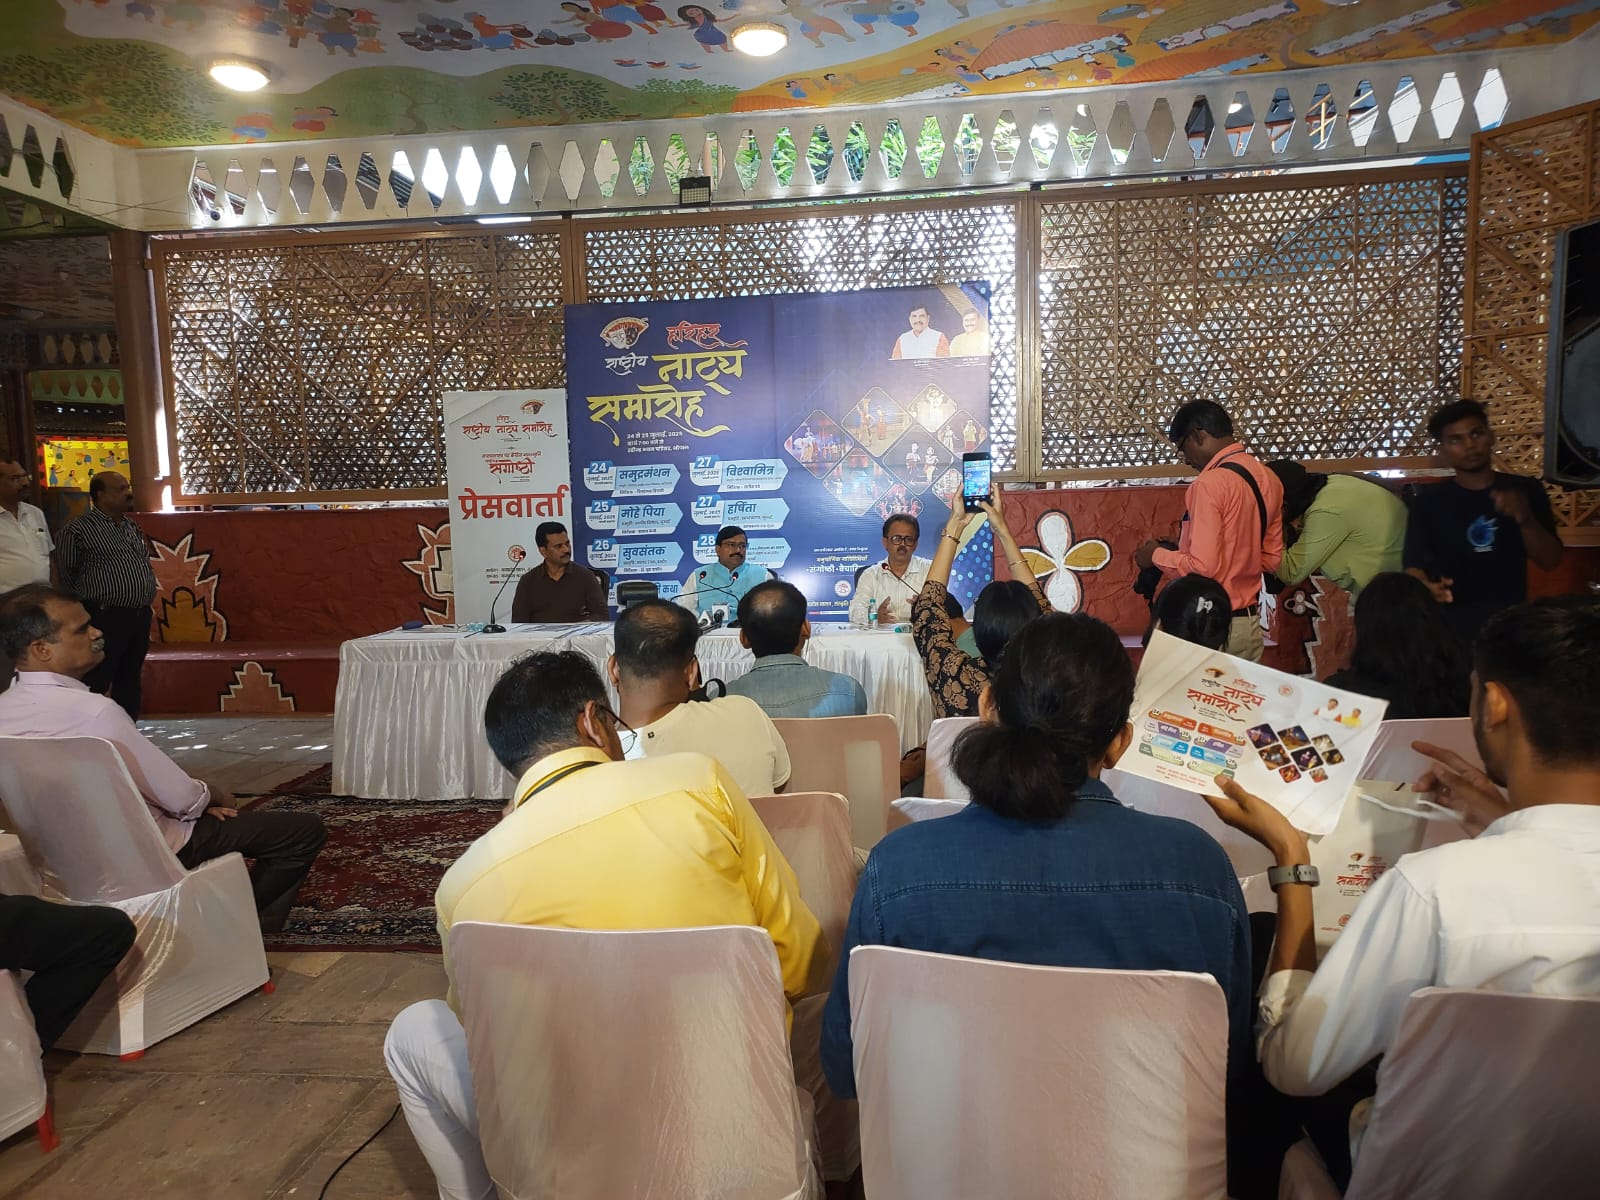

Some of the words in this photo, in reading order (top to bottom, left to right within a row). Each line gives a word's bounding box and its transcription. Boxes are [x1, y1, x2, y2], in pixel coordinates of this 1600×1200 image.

[666, 320, 748, 349] हरिहर
[605, 352, 648, 375] राष्ट्रीय
[652, 350, 748, 394] नाट्य
[586, 384, 732, 446] समारोह
[591, 462, 607, 473] 24
[697, 457, 712, 467] 27
[619, 466, 671, 482] समुद्रमंथन
[726, 463, 775, 477] विश्वामित्र
[458, 485, 569, 520] प्रेसवार्ता
[594, 501, 609, 512] 25
[699, 496, 713, 507] 27
[727, 501, 757, 515] हर्षिता
[621, 505, 641, 519] मोहे
[642, 504, 666, 518] पिया
[595, 540, 610, 551] 26
[700, 535, 716, 546] 28
[622, 545, 667, 560] सुवसंतक
[662, 585, 679, 593] कथा
